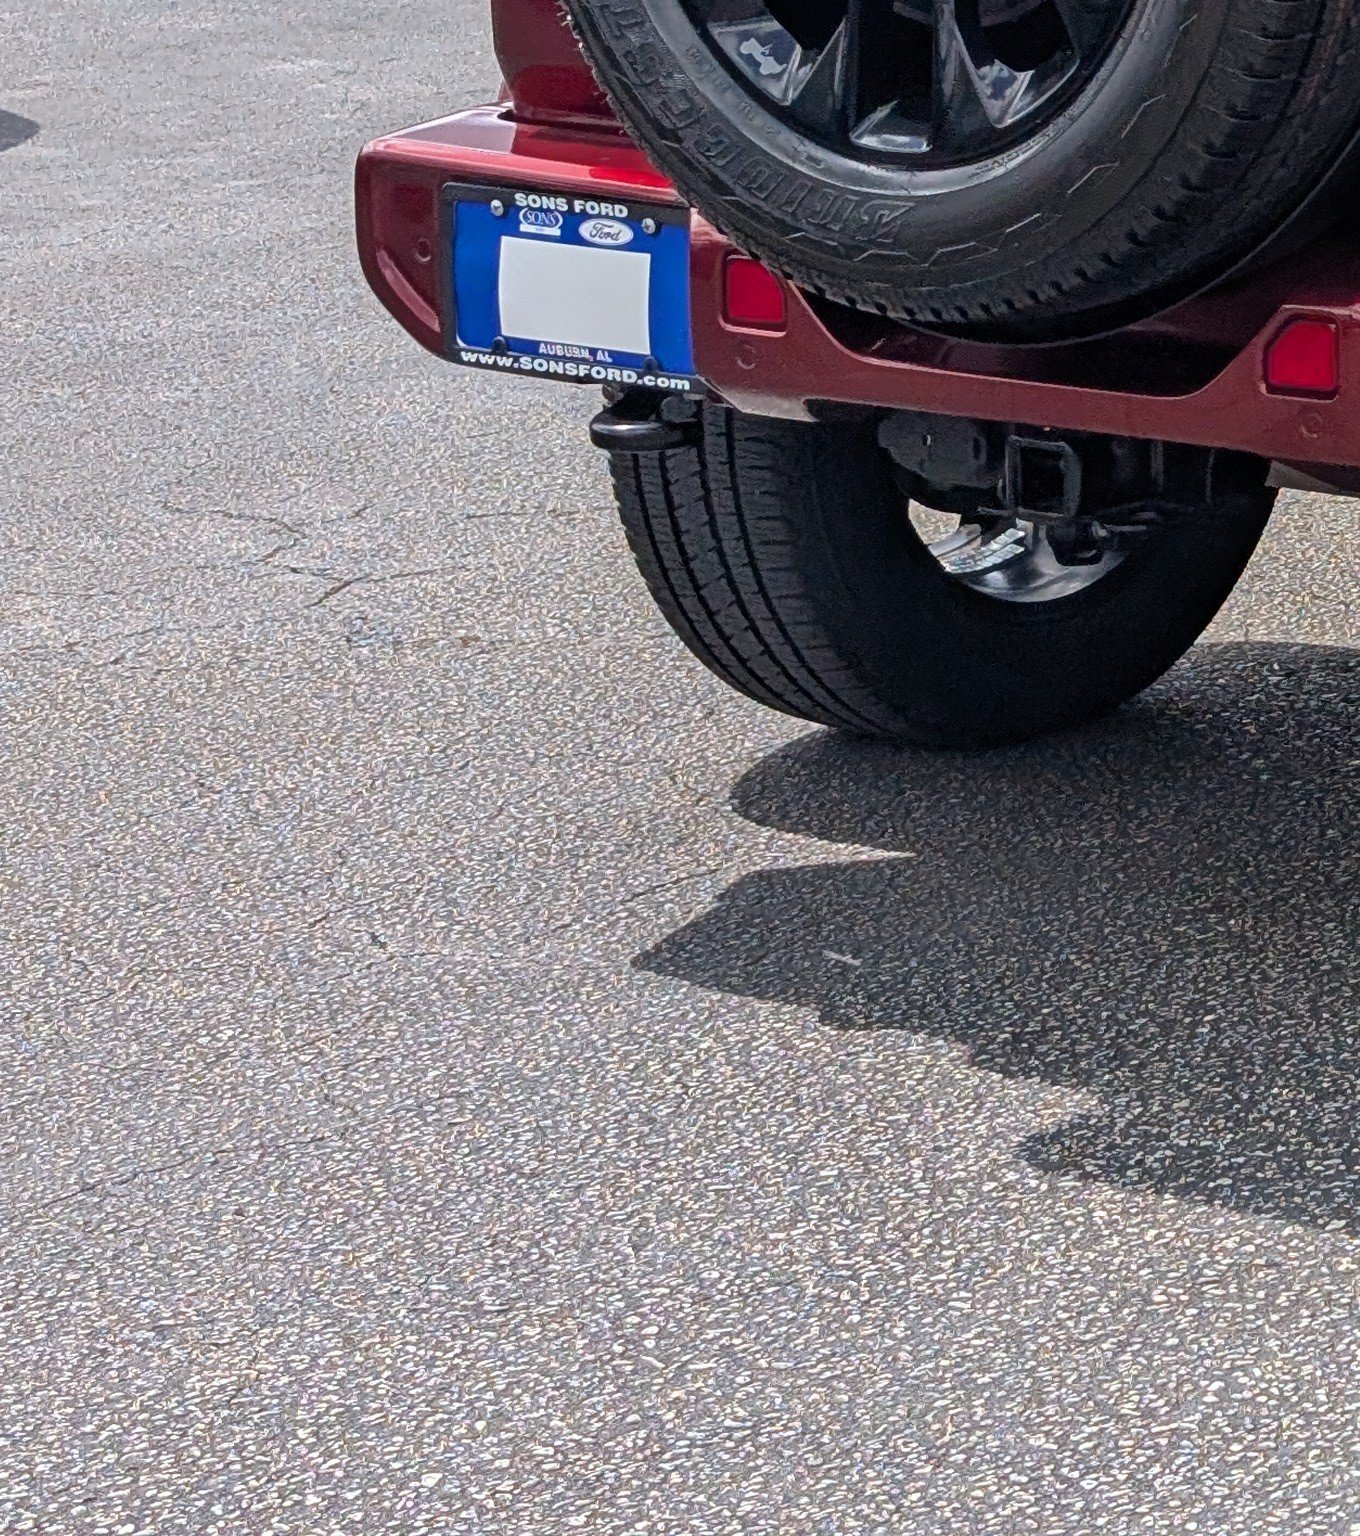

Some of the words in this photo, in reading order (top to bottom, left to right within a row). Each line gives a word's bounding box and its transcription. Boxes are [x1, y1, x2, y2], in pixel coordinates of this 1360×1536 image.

[514, 192, 569, 212] SONS
[573, 199, 629, 218] FORD
[589, 221, 622, 242] Ford
[596, 347, 613, 363] AL
[460, 350, 691, 391] www.SONSFORD.com
